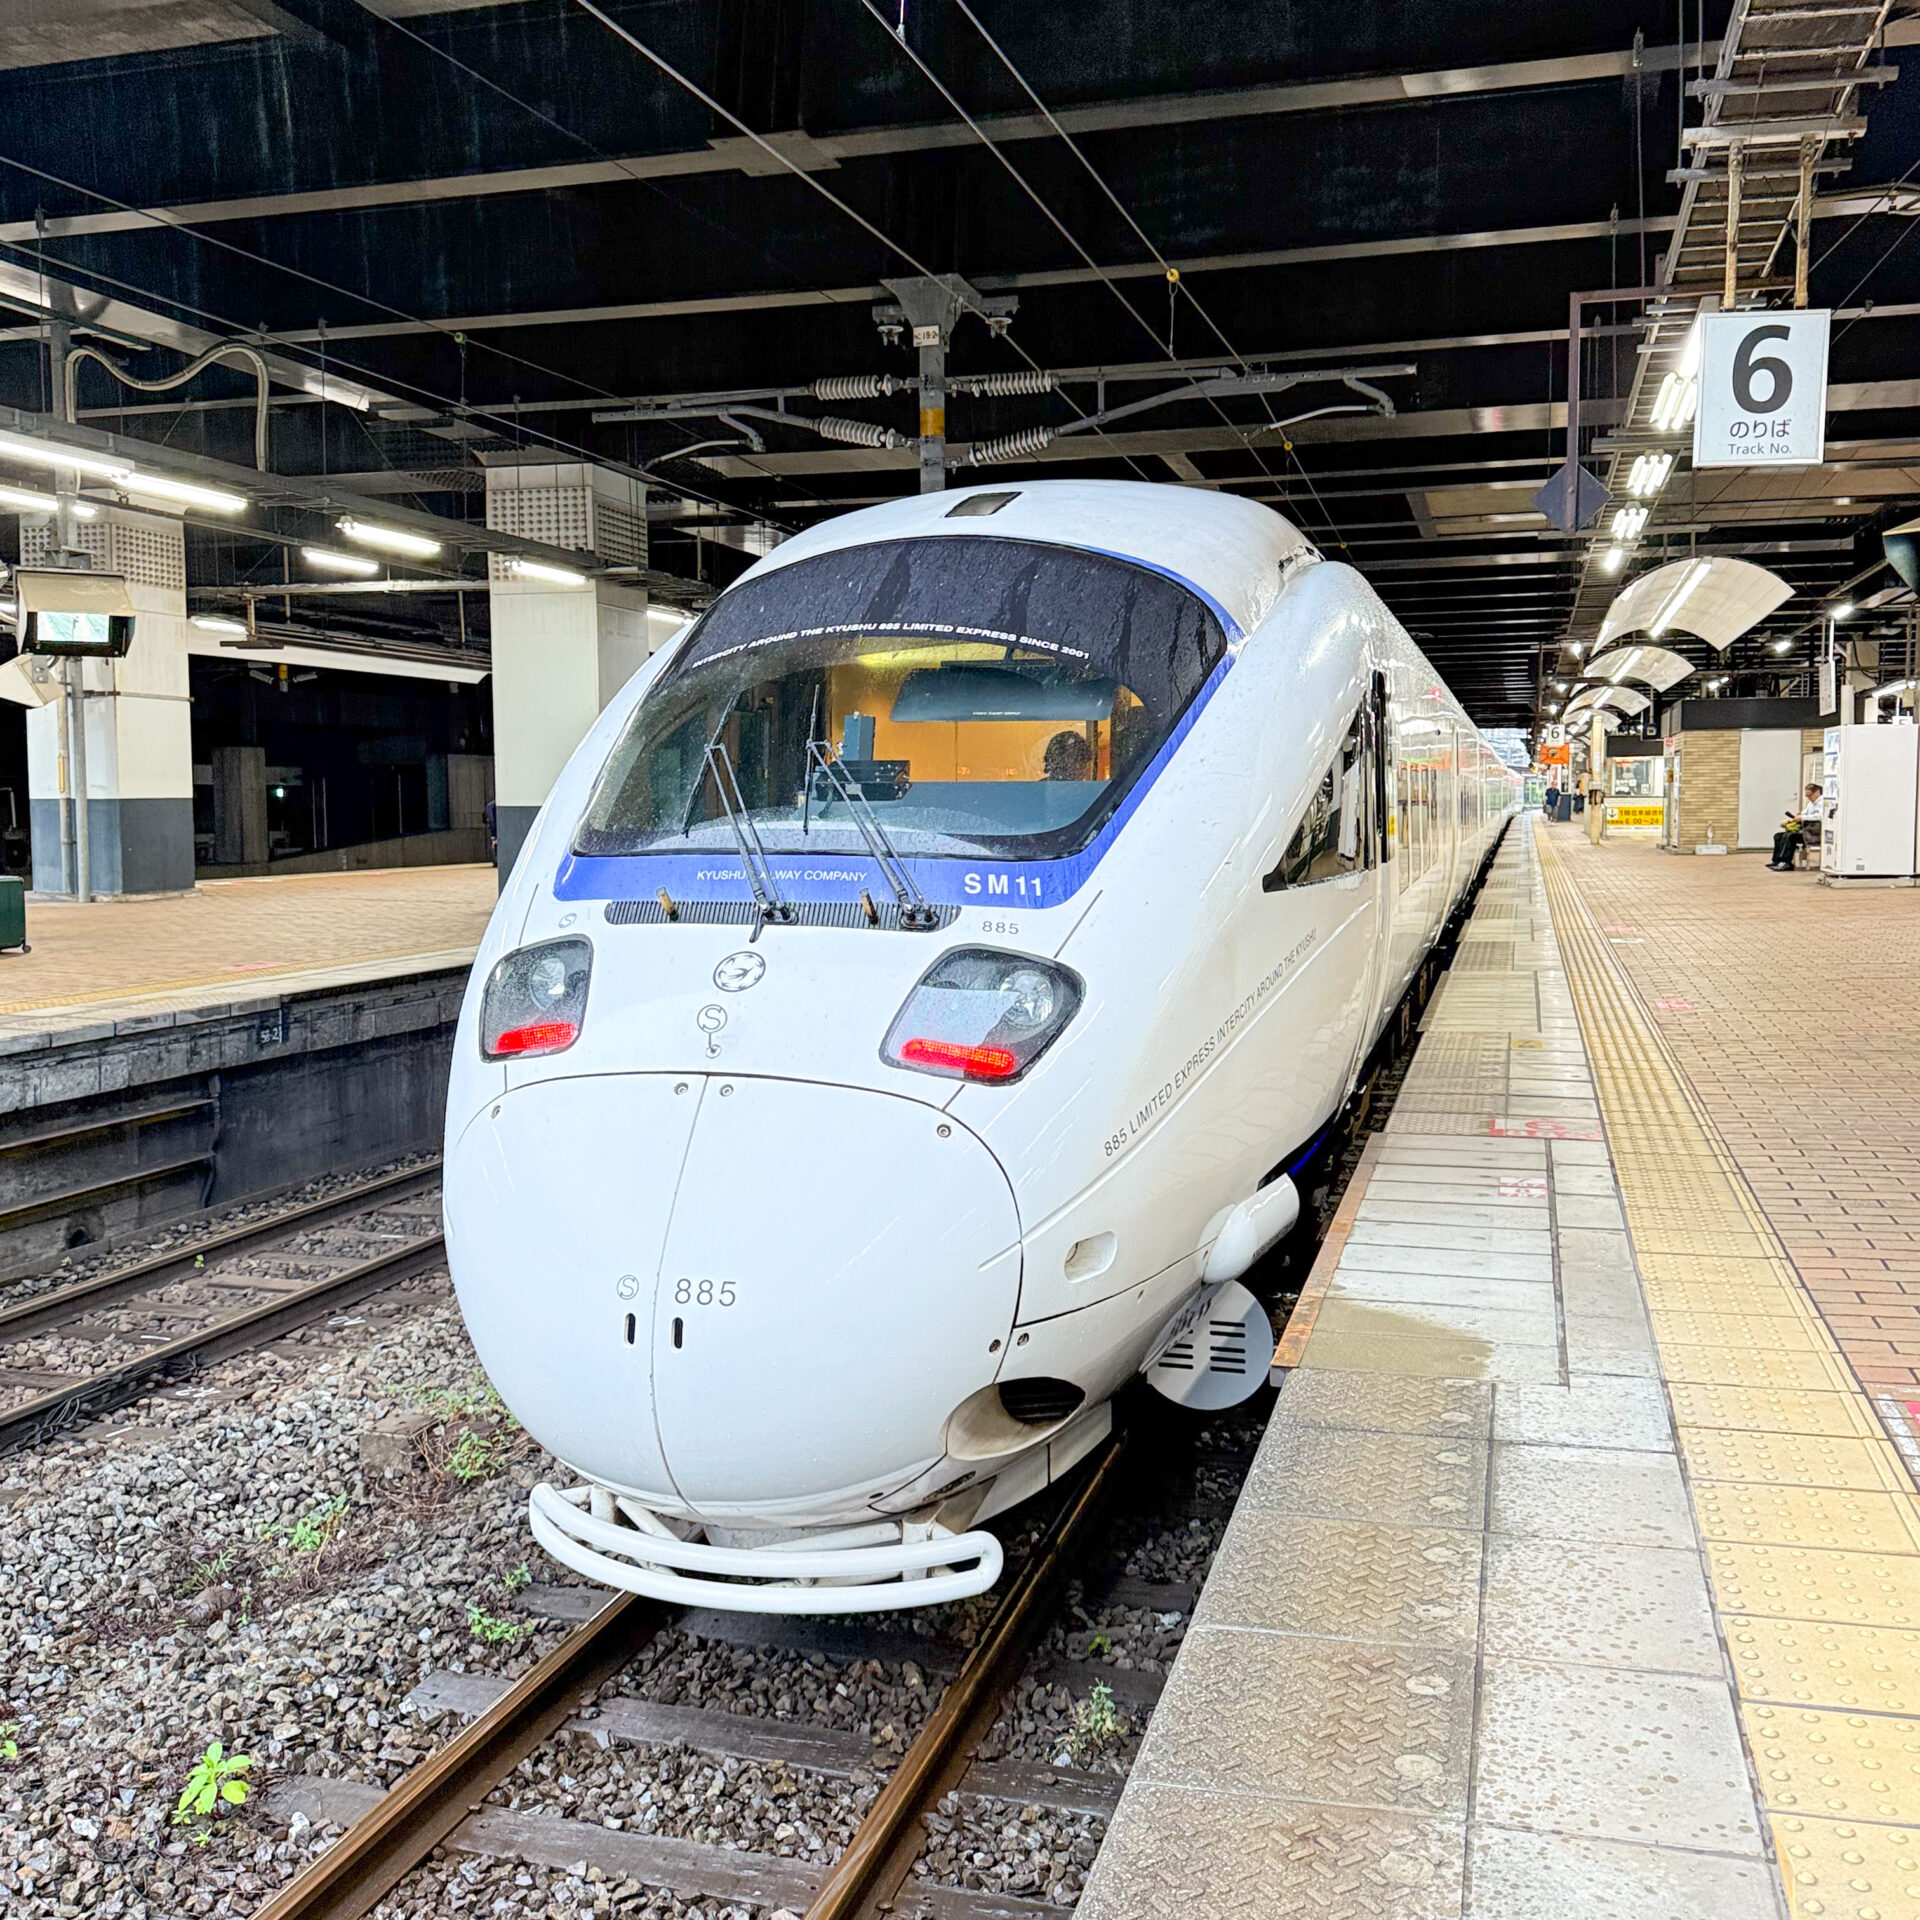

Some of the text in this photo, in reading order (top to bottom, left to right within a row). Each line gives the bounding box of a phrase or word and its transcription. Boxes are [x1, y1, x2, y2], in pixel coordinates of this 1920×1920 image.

[1732, 324, 1793, 414] 6
[1729, 418, 1792, 439] のりば
[1728, 442, 1792, 455] Track No.
[692, 622, 1091, 669] INTERCITY AROUND THE KYUSHU 885 LIMITED EXPRESS SINCE 2001
[1551, 726, 1560, 739] 6
[696, 869, 747, 881] KYUSHU
[803, 869, 868, 882] COMPANY
[982, 920, 1019, 935] 885
[1104, 926, 1317, 1157] 885 LIMITED EXPRESS INTERCITY AROUND THE KYUSHU
[674, 1278, 737, 1307] 885
